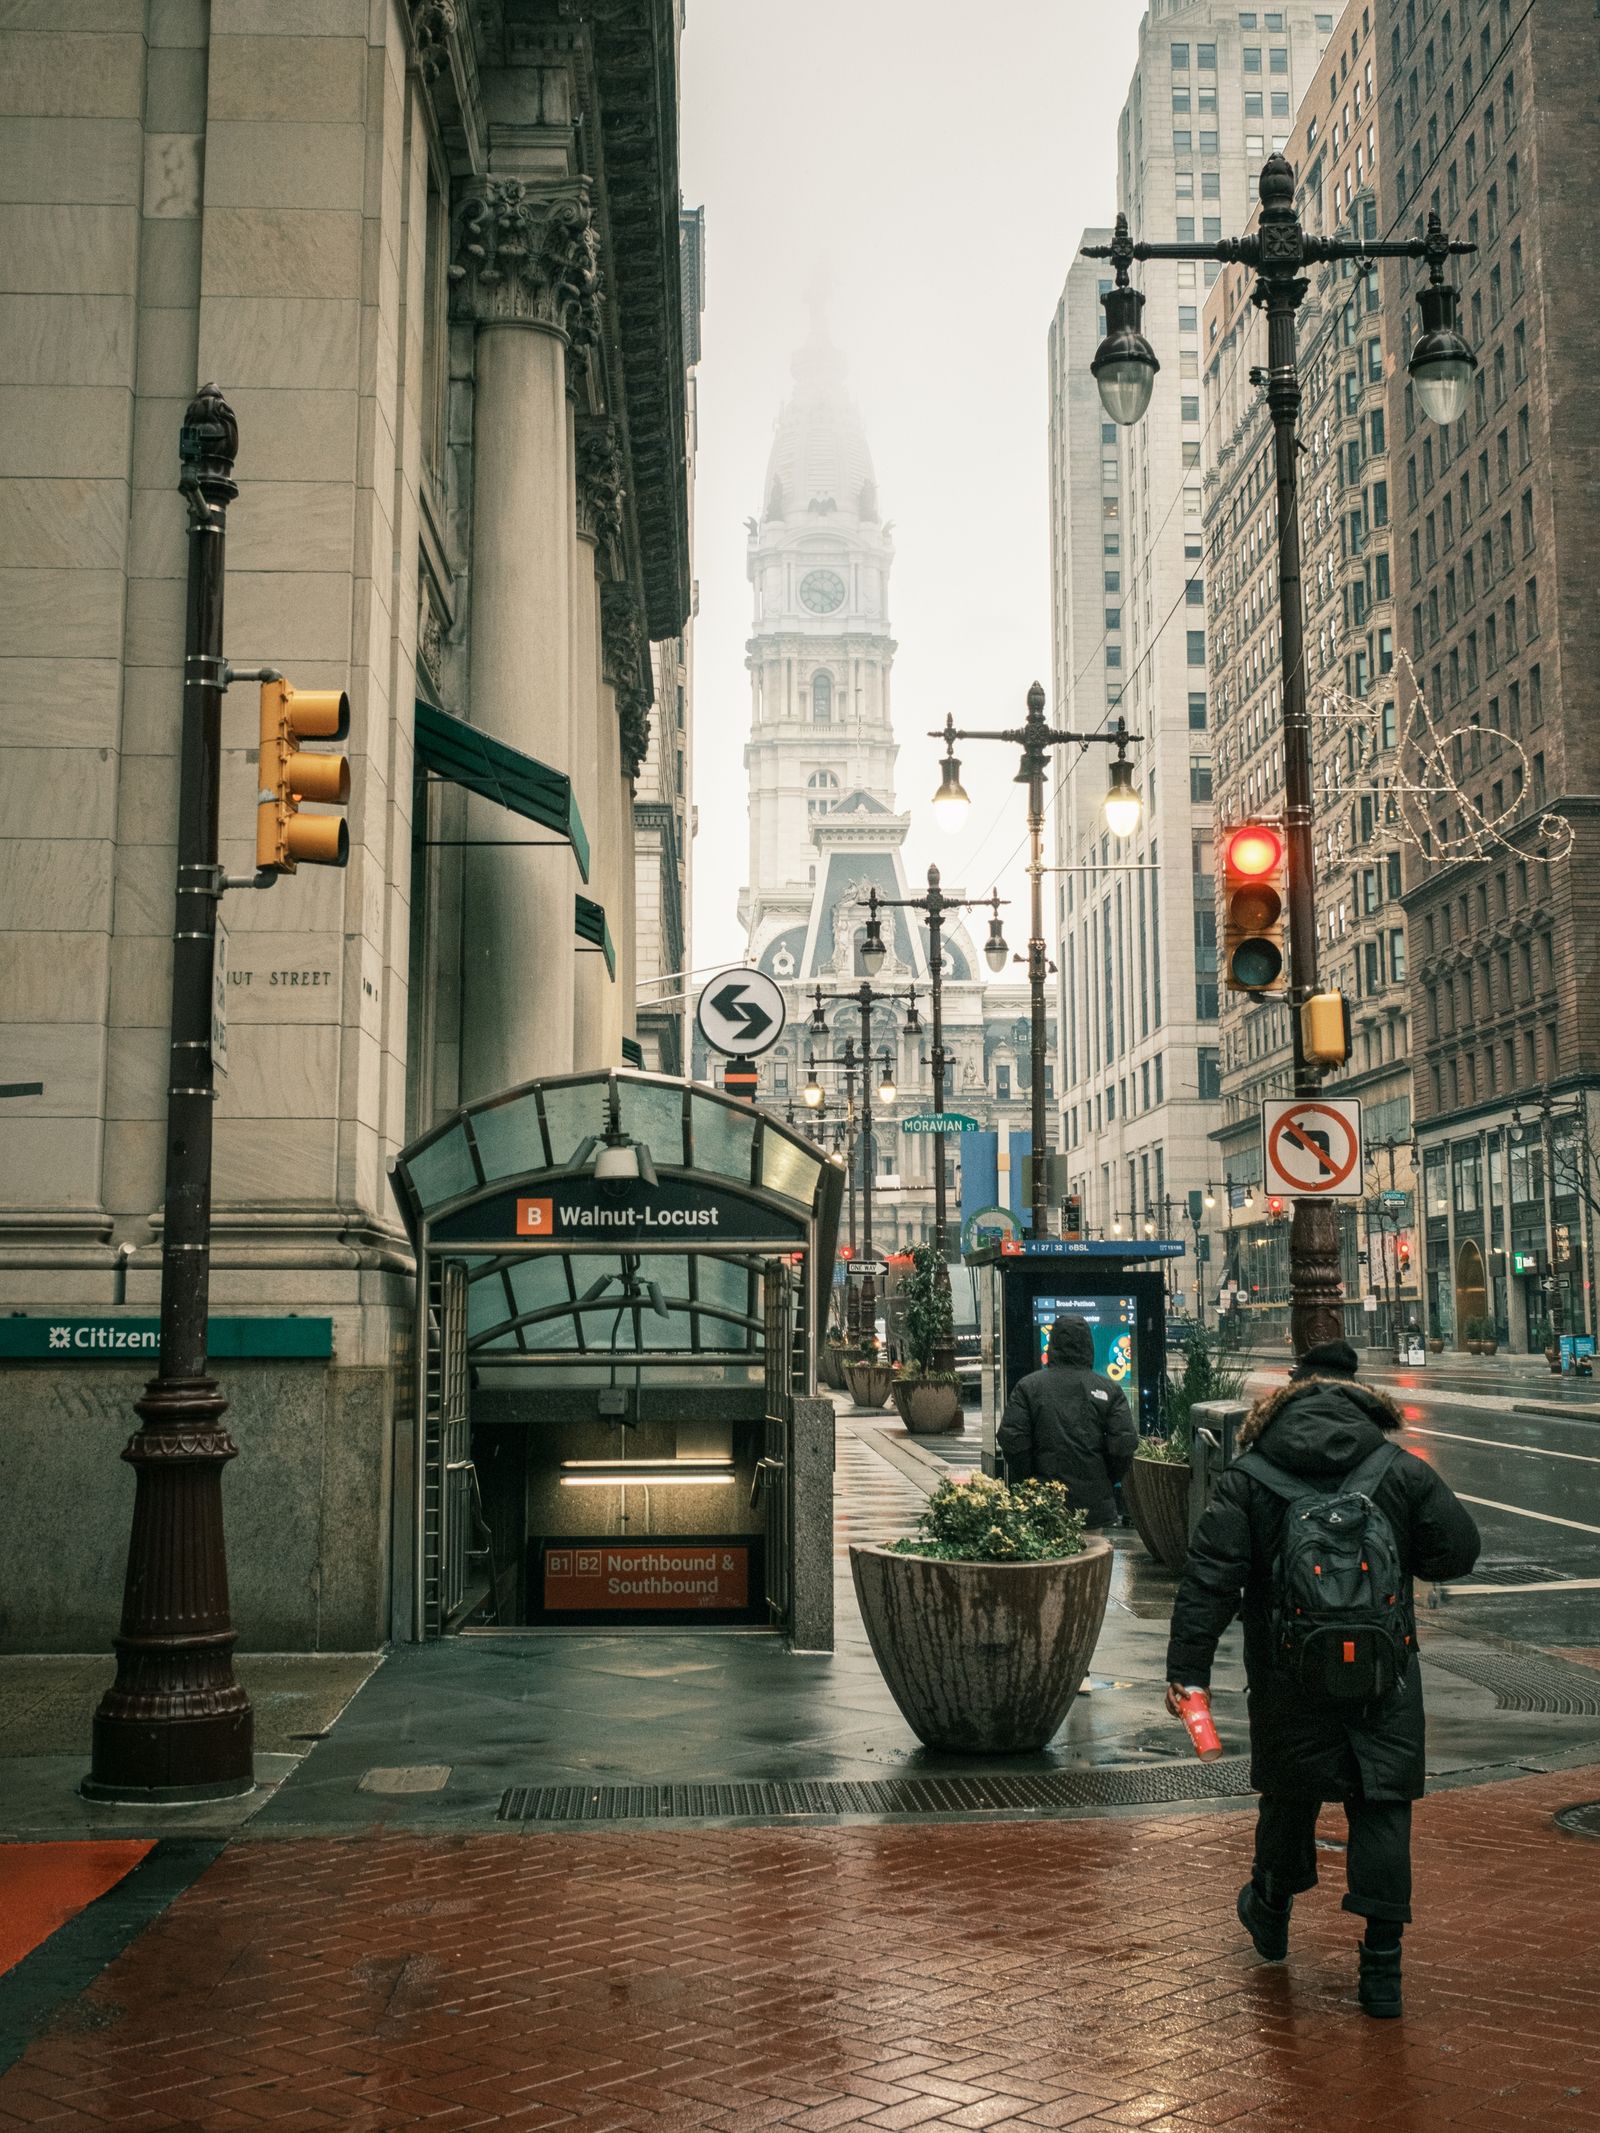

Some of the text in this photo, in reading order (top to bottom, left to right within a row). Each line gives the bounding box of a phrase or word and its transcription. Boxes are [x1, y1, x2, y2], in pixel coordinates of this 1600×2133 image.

[269, 971, 332, 986] STREET
[904, 1120, 976, 1132] MORAVIAN ST
[527, 1205, 719, 1227] B Walnut-Locust
[550, 1554, 735, 1572] B1 B2 Northbound &
[608, 1577, 719, 1594] Southbound
